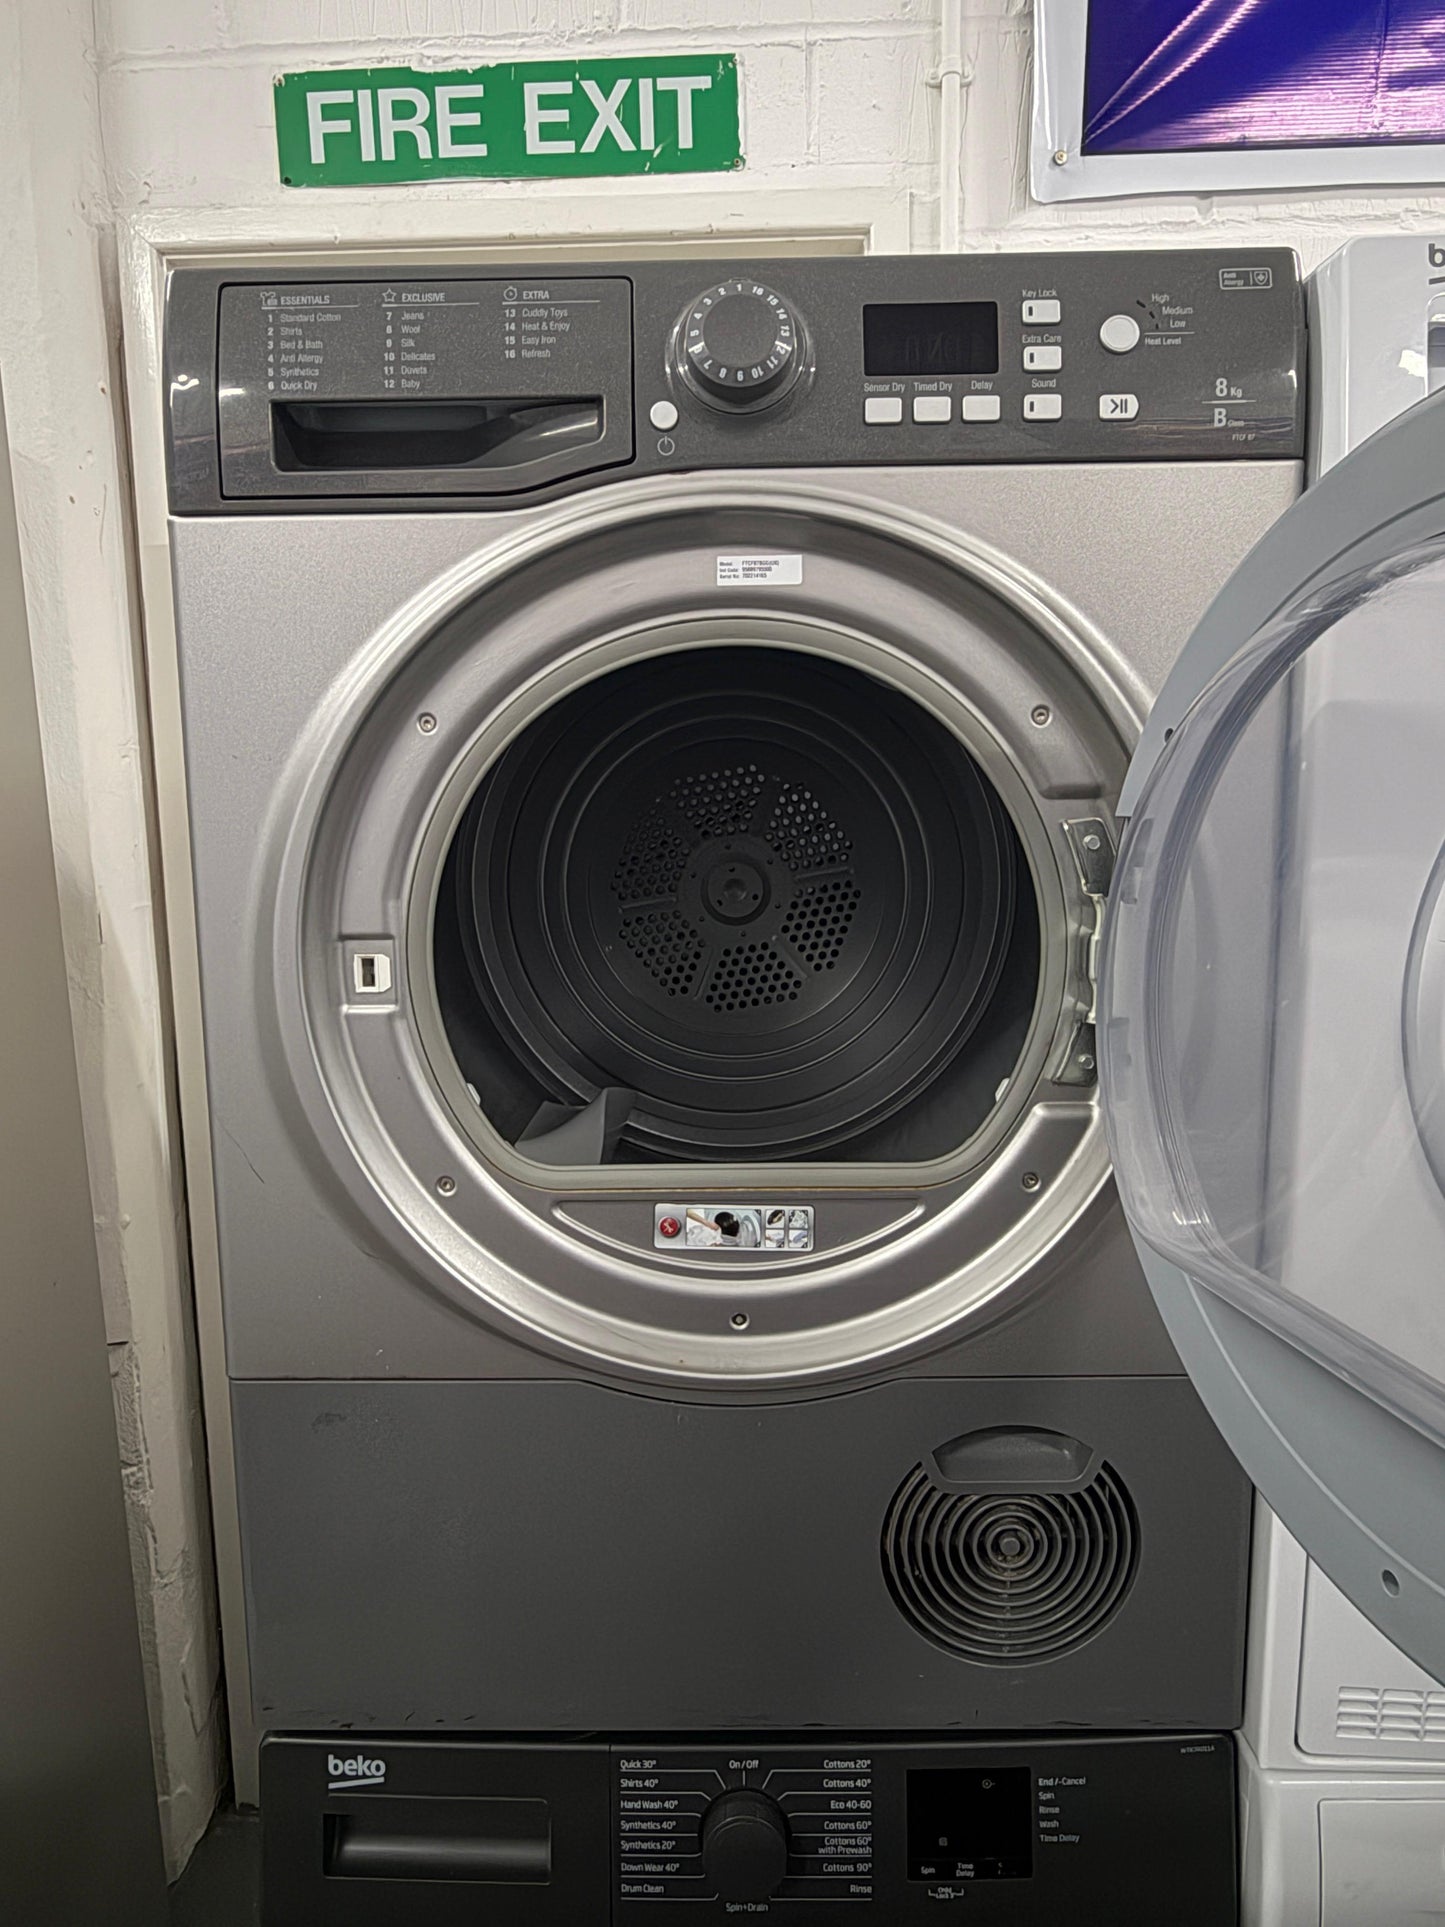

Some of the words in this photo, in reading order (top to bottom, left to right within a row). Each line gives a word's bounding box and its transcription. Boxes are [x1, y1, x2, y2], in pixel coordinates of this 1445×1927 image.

[305, 84, 488, 164] FIRE
[523, 76, 713, 155] EXIT
[522, 290, 550, 300] EXTRA
[718, 287, 726, 295] 2
[1022, 289, 1036, 299] Key
[1038, 288, 1057, 297] Lock
[280, 295, 330, 305] ESSENTIALS
[402, 292, 446, 302] EXCLUSIVE
[766, 294, 779, 306] 15
[1152, 294, 1170, 303] High
[703, 298, 712, 306] 3
[504, 309, 516, 318] 13
[522, 308, 548, 318] Cuddly
[550, 308, 568, 320] Toys
[1162, 306, 1193, 315] Medium
[268, 314, 274, 322] 1
[280, 313, 314, 322] Standard
[316, 312, 342, 322] Cotton
[386, 312, 392, 320] 7
[401, 311, 424, 320] Jeans
[504, 322, 516, 331] 14
[522, 322, 540, 330] Heat
[541, 322, 548, 330] &
[550, 321, 570, 332] Enjoy
[1170, 320, 1186, 328] Low
[268, 327, 274, 336] 2
[280, 327, 302, 336] Shirts
[386, 325, 392, 334] 8
[401, 325, 420, 334] Wool
[780, 326, 790, 337] 13
[386, 338, 392, 348] 9
[401, 338, 415, 347] Silk
[504, 336, 516, 345] 15
[522, 336, 540, 346] Easy
[541, 336, 556, 344] Iron
[1022, 334, 1042, 343] Extra
[1044, 334, 1062, 343] Care
[1145, 338, 1161, 346] Heat
[1163, 337, 1182, 345] Level
[268, 341, 274, 350] 3
[280, 341, 296, 350] Bed
[297, 340, 304, 349] &
[306, 340, 323, 348] Bath
[384, 352, 395, 361] 10
[401, 352, 436, 361] Delicates
[504, 350, 516, 358] 16
[522, 349, 551, 359] Refresh
[268, 354, 274, 362] 4
[280, 354, 296, 363] Anti
[298, 354, 323, 364] Allergy
[704, 360, 712, 370] 7
[268, 368, 274, 376] 5
[280, 368, 320, 378] Synthetics
[384, 366, 394, 375] 11
[401, 366, 427, 375] Duvets
[752, 366, 764, 379] 10
[268, 381, 274, 390] 6
[280, 381, 302, 390] Quick
[304, 380, 318, 391] Dry
[384, 380, 395, 388] 12
[401, 379, 420, 390] Baby
[864, 383, 890, 391] Sensor
[892, 382, 905, 393] Dry
[914, 382, 938, 391] Timed
[939, 382, 952, 392] Dry
[971, 380, 993, 391] Delay
[1032, 379, 1056, 388] Sound
[1216, 378, 1227, 397] 8
[1230, 387, 1242, 398] Kg
[1214, 408, 1227, 427] B
[328, 1754, 386, 1776] beko
[620, 1760, 642, 1770] Quick
[729, 1760, 740, 1769] On
[746, 1760, 759, 1769] Off
[824, 1760, 854, 1769] Cottons
[620, 1779, 643, 1788] Shirts
[823, 1779, 854, 1788] Cottons
[1038, 1778, 1054, 1786] End
[1038, 1792, 1055, 1800] Spin
[620, 1800, 641, 1809] Hand
[642, 1800, 662, 1809] Wash
[831, 1800, 844, 1809] Eco
[846, 1800, 872, 1809] 40-60
[1039, 1805, 1060, 1814] Rinse
[620, 1820, 661, 1831] Synthetics
[824, 1821, 855, 1830] Cottons
[824, 1837, 856, 1846] Cottons
[1059, 1834, 1080, 1843] Delay
[620, 1840, 661, 1851] Synthetics
[818, 1846, 836, 1854] with
[836, 1846, 872, 1854] Prewash
[621, 1863, 643, 1872] Down
[644, 1863, 664, 1872] Wear
[823, 1863, 855, 1872] Cottons
[921, 1866, 936, 1875] Spin
[956, 1870, 975, 1878] Delay
[621, 1884, 642, 1893] Drum
[643, 1884, 664, 1893] Clean
[850, 1884, 872, 1893] Rinse
